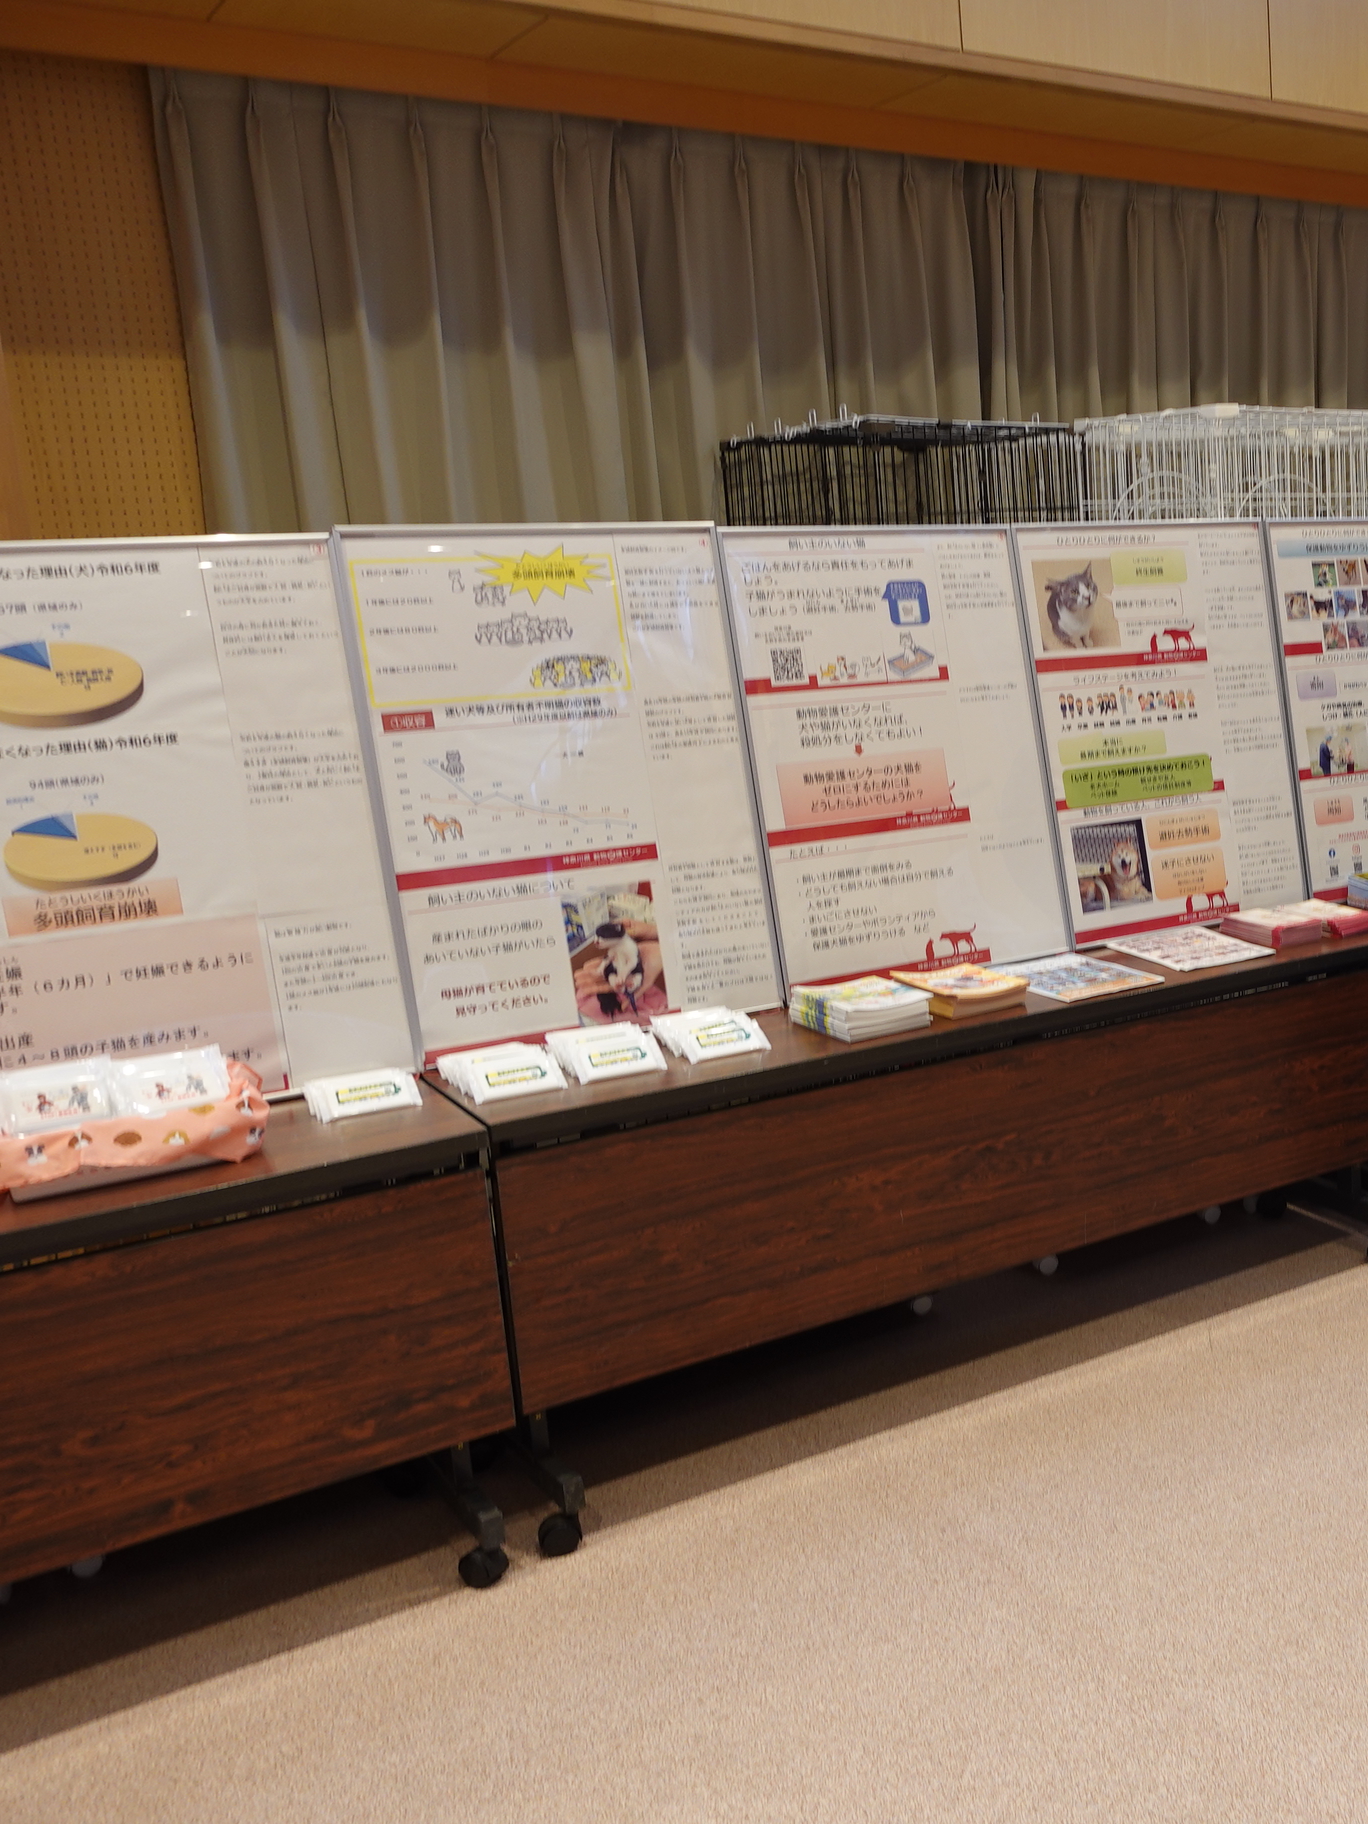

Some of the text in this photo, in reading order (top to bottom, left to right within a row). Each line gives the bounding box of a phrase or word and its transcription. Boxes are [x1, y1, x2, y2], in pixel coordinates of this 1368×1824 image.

[34, 899, 159, 931] 多頭飼育崩壊
[0, 965, 22, 982] 娠
